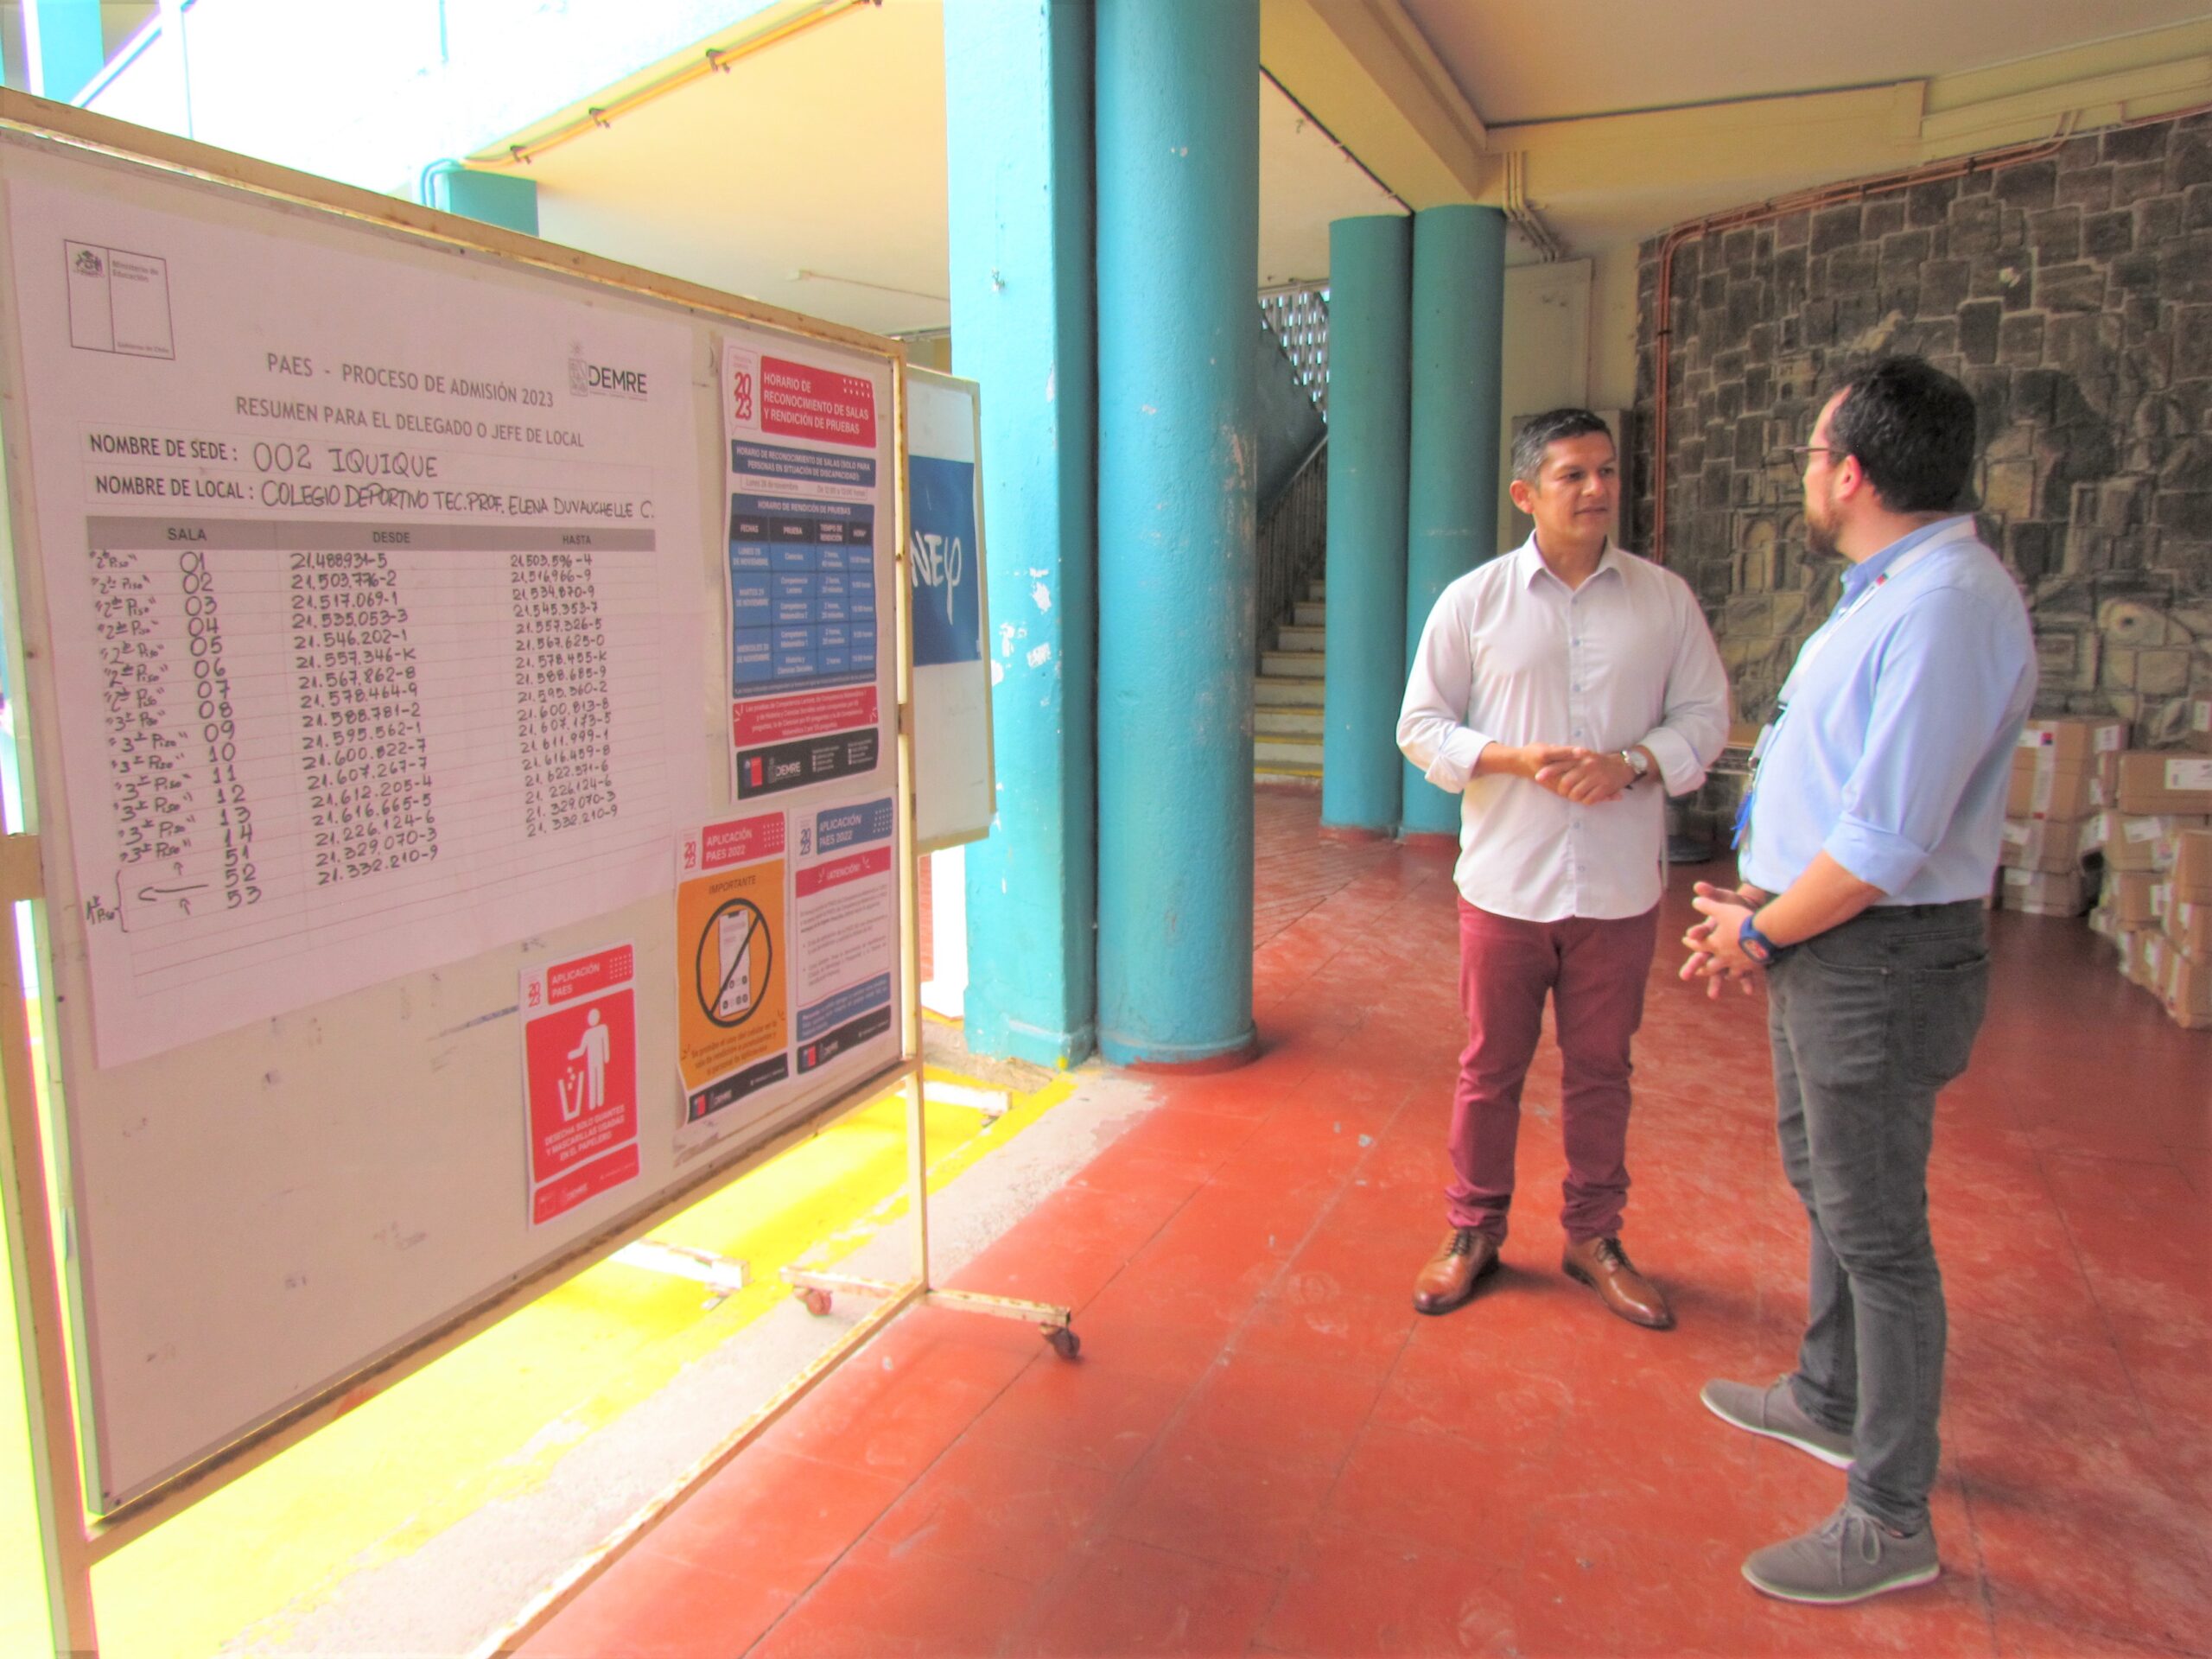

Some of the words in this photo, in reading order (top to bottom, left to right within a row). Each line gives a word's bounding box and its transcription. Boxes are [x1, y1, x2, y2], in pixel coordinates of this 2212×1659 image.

[268, 353, 313, 377] PAES
[342, 364, 418, 390] PROCESO
[424, 374, 445, 394] DE
[450, 378, 517, 403] ADMISIÓN
[522, 388, 554, 407] 2023
[588, 365, 648, 395] DEMRE
[764, 373, 800, 391] HORARIO
[801, 381, 811, 392] DE
[764, 391, 832, 414] RECONOCIMIENTO
[834, 404, 845, 416] DE
[846, 405, 869, 420] SALAS
[237, 397, 319, 422] RESUMEN
[324, 406, 367, 428] PARA
[372, 411, 391, 429] EL
[397, 414, 472, 437] DELEGADO
[477, 423, 486, 438] O
[492, 424, 522, 442] JEFE
[526, 428, 543, 443] DE
[546, 429, 585, 448] LOCAL
[764, 409, 769, 419] Y
[771, 410, 813, 429] RENDICIÓN
[815, 417, 824, 429] DE
[826, 420, 860, 434] PRUEBAS
[90, 434, 161, 456] NOMBRE
[166, 439, 185, 458] DE
[253, 442, 312, 473] 002
[328, 448, 438, 477] IQUIQUE
[96, 475, 166, 497] NOMBRE
[171, 478, 190, 497] DE
[261, 480, 340, 507] COLEGIO
[344, 482, 429, 510] DEPORTIVO
[509, 496, 549, 515] ELENA
[168, 528, 207, 541] SALA
[372, 531, 410, 543] DESDE
[563, 536, 591, 545] HASTA
[180, 551, 206, 573] 01
[182, 572, 213, 594] 02
[185, 595, 217, 616] 03
[188, 617, 219, 637] 04
[190, 636, 223, 657] 05
[194, 658, 226, 678] 06
[197, 679, 230, 699] 07
[199, 700, 233, 719] 08
[204, 720, 235, 742] 09
[209, 742, 236, 762] 10
[213, 765, 236, 784] 11
[217, 785, 245, 804] 12
[220, 806, 251, 826] 13
[225, 823, 252, 847] 14
[706, 828, 753, 847] APLICACIÓN
[225, 847, 249, 867] 51
[705, 849, 727, 861] PAES
[728, 846, 747, 858] 2022
[225, 864, 256, 887] 52
[709, 875, 757, 894] IMPORTANTE
[227, 887, 262, 909] 53
[552, 963, 600, 983] APLICACIÓN
[552, 984, 573, 997] PAES
